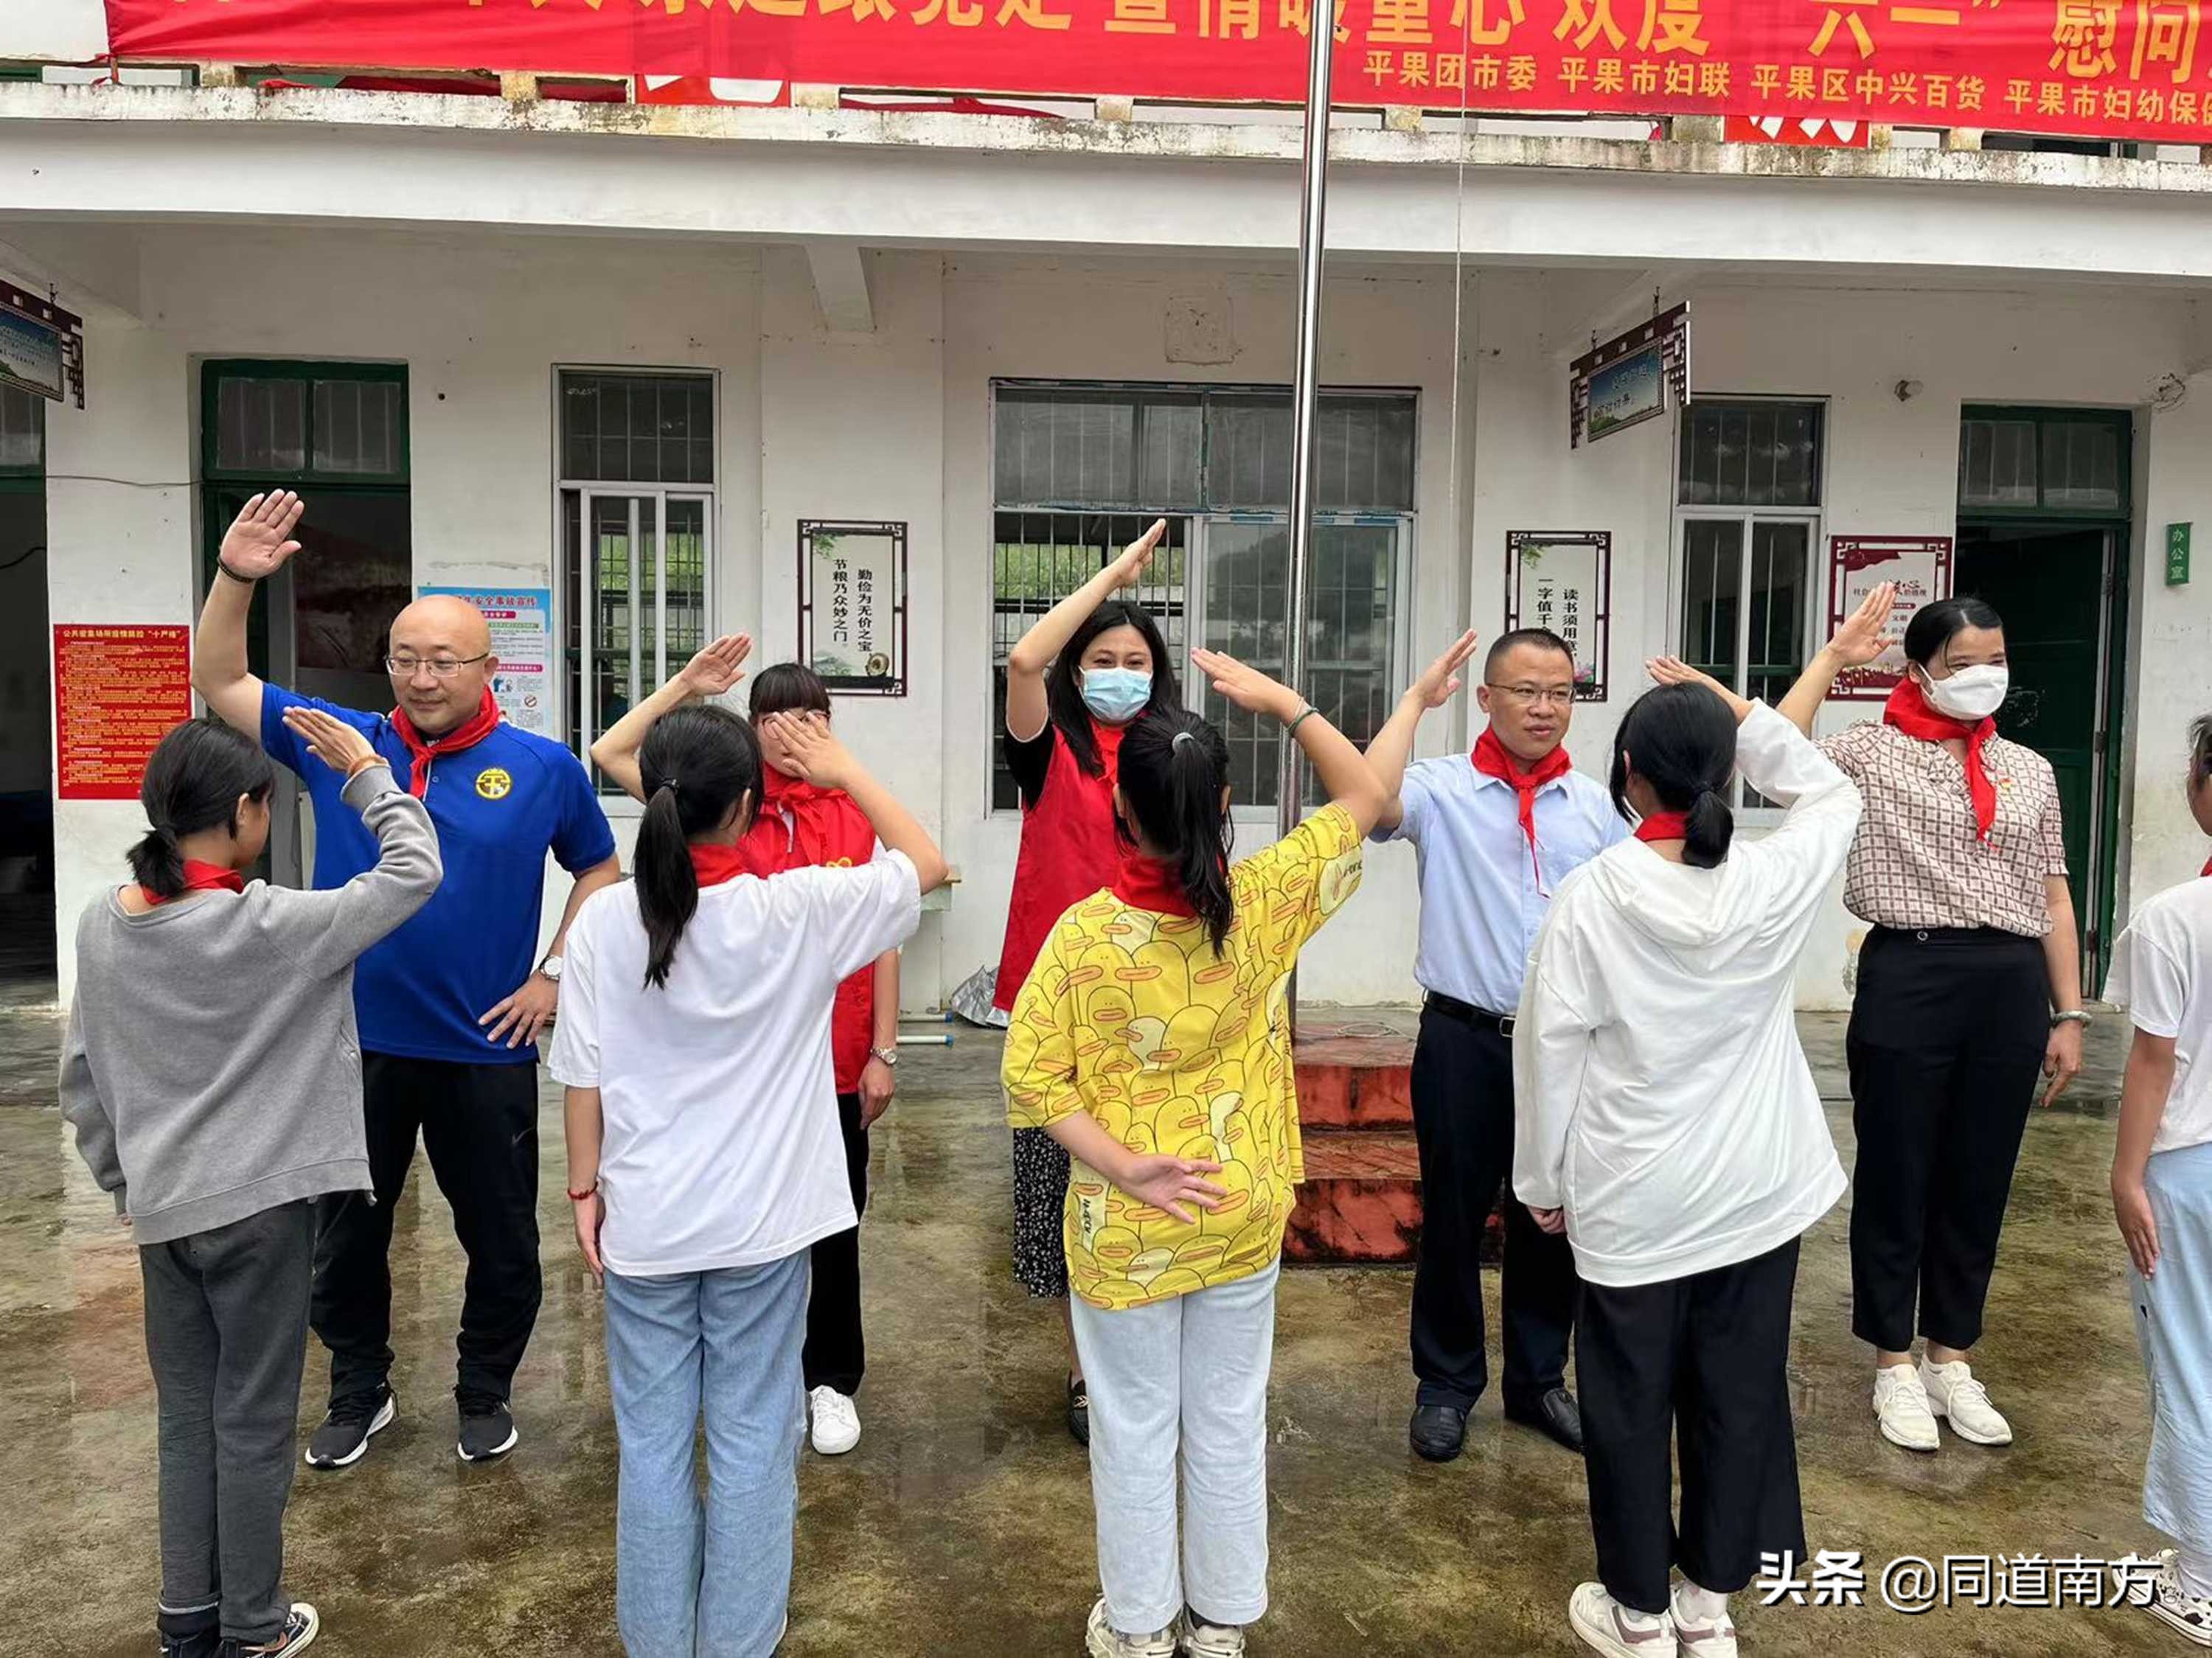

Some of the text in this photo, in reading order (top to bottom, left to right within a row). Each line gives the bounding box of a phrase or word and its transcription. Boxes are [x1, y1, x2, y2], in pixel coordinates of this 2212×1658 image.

[1363, 49, 1537, 91] 平果团市委
[1557, 56, 1731, 97] 平果市妇联
[1750, 63, 1986, 111] 平果区中兴百货
[2171, 529, 2184, 579] 办公室
[832, 558, 849, 642] 节粮乃众妙之门
[857, 568, 873, 652] 勤俭为无价之宝
[1537, 578, 1554, 633] 一字值千
